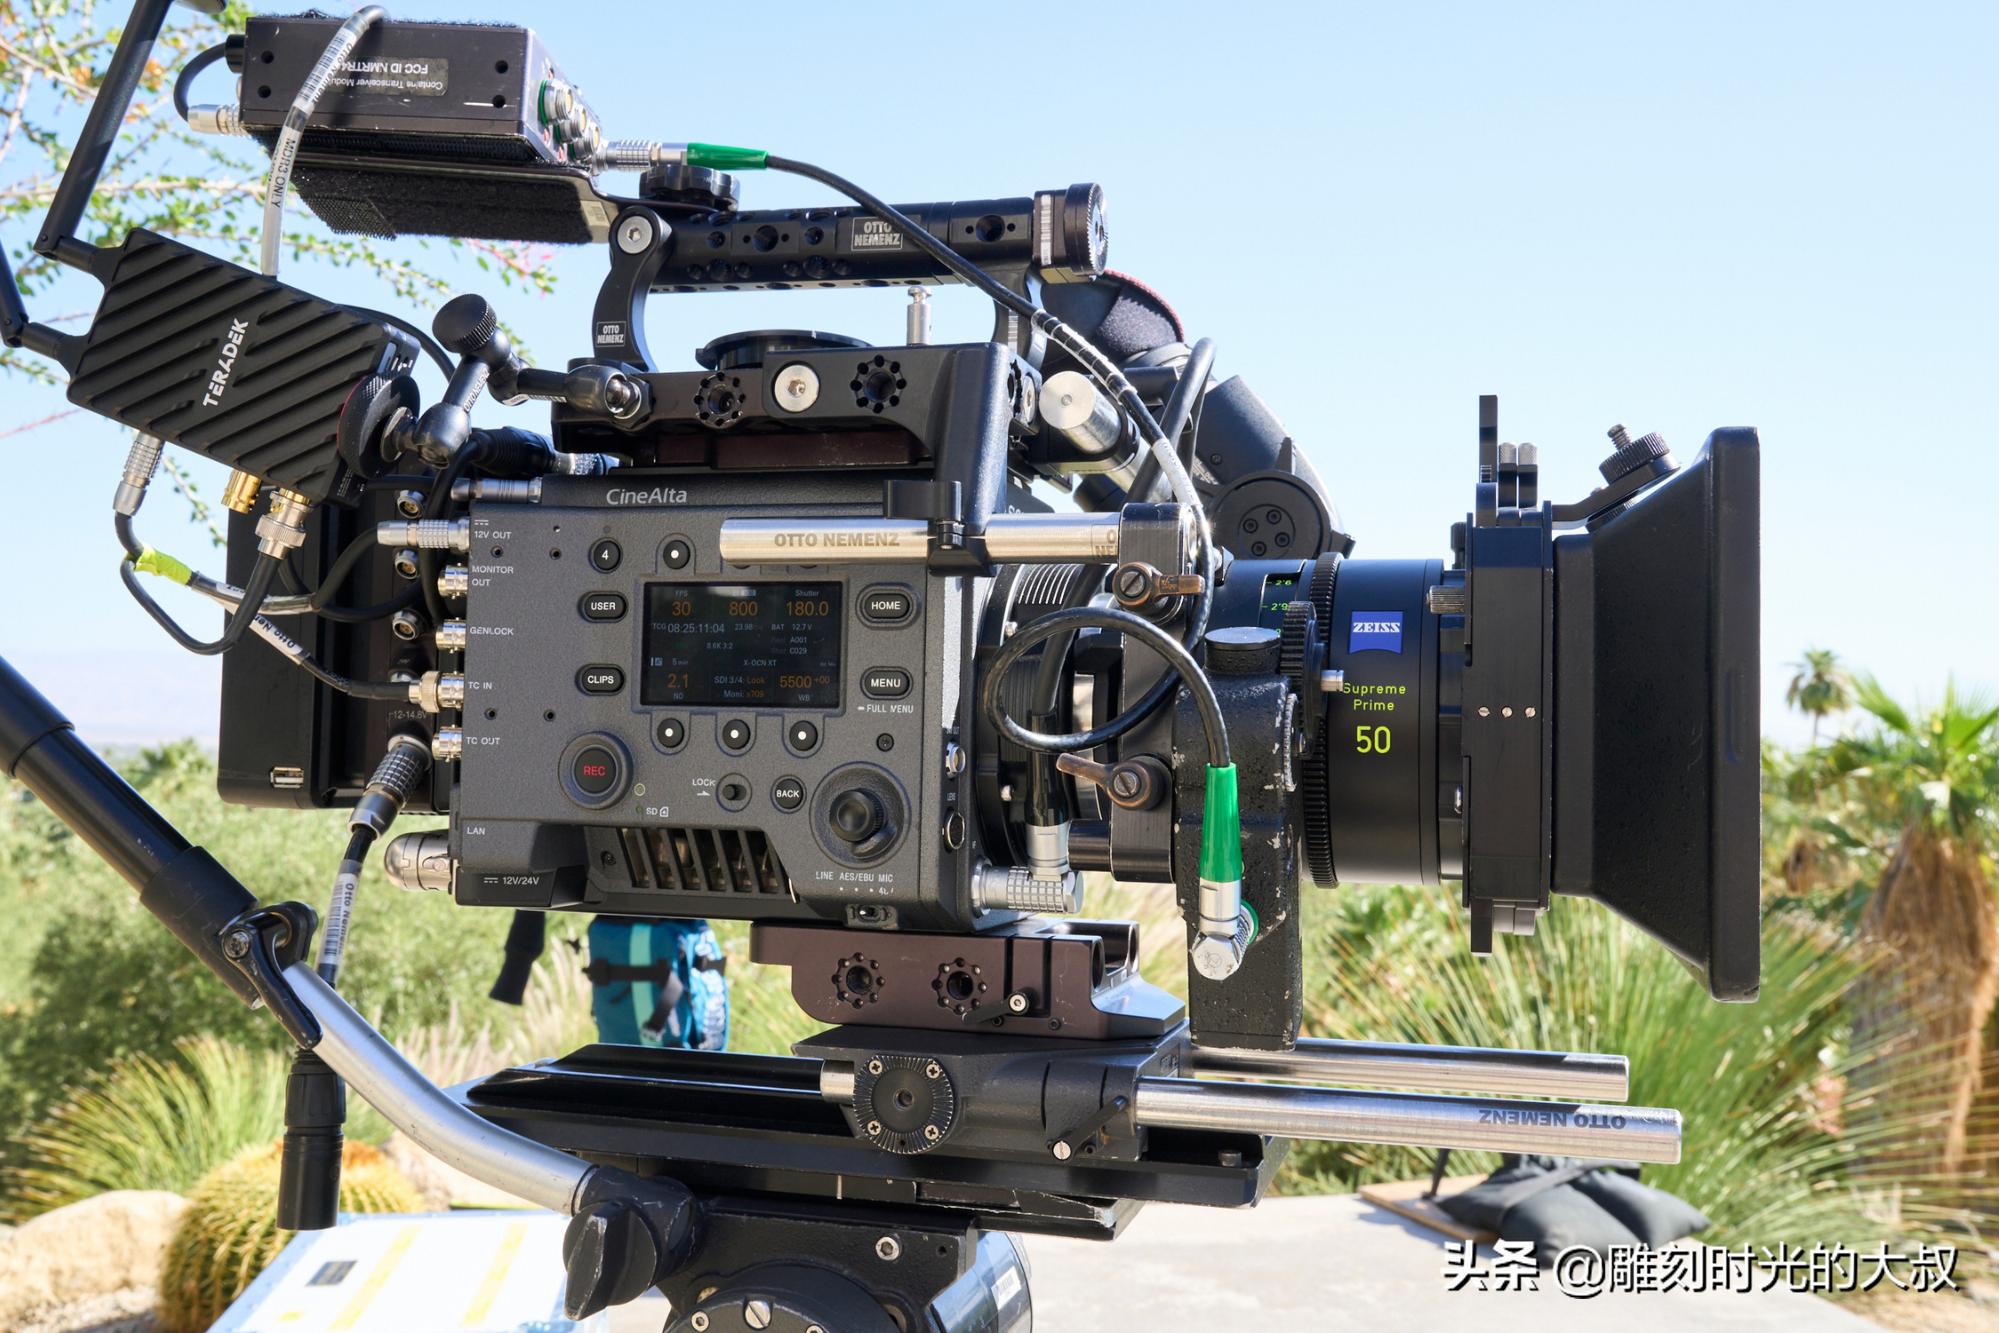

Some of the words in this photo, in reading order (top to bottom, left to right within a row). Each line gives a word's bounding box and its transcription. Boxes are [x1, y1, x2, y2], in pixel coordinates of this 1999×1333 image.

[341, 61, 388, 73] NMRTR4
[390, 62, 402, 73] ID
[404, 63, 429, 74] FCC
[330, 77, 355, 87] Modu
[356, 78, 404, 89] Transceiver
[406, 80, 443, 90] Contains
[271, 176, 286, 208] ONLY
[863, 221, 892, 234] OTTO
[854, 233, 900, 247] NEMENZ
[602, 324, 620, 335] OTTO
[597, 333, 624, 344] NEMENZ
[202, 317, 249, 407] TERADEK
[606, 487, 688, 505] CineAlta
[474, 530, 490, 539] 12V
[492, 531, 513, 540] OUT
[774, 533, 818, 547] OTTO
[823, 532, 900, 547] NEMENZ
[601, 549, 609, 560] 4
[471, 565, 514, 574] MONITOR
[471, 578, 491, 587] OUT
[590, 602, 616, 611] USER
[671, 601, 693, 616] 30
[728, 601, 758, 616] 800
[786, 601, 829, 617] 180.0
[871, 601, 901, 610] HOME
[469, 626, 514, 636] GENLOCK
[667, 623, 725, 633] 08:25:11:04
[1352, 621, 1401, 633] ZEISS
[274, 630, 296, 649] Otto
[467, 681, 480, 690] TC
[483, 682, 493, 690] IN
[587, 675, 615, 685] CLIPS
[666, 672, 689, 689] 2.1
[780, 675, 812, 688] 5500
[870, 678, 901, 688] MENU
[1343, 682, 1408, 696] Supreme
[866, 704, 887, 713] FULL
[890, 704, 914, 714] MENU
[1353, 699, 1395, 711] Prime
[466, 736, 478, 745] TC
[480, 737, 501, 745] OUT
[1356, 725, 1391, 754] 50
[583, 765, 606, 776] REC
[692, 778, 716, 786] LOCK
[776, 789, 800, 798] BACK
[646, 807, 658, 815] SD
[466, 827, 486, 835] LAN
[502, 876, 540, 885] 12V/24V
[815, 871, 834, 880] LINE
[839, 872, 875, 882] AES/EBU
[878, 873, 894, 883] MIC
[343, 882, 355, 907] Otto
[1479, 1109, 1567, 1128] NEMENZ
[1574, 1113, 1627, 1130] OTTO
